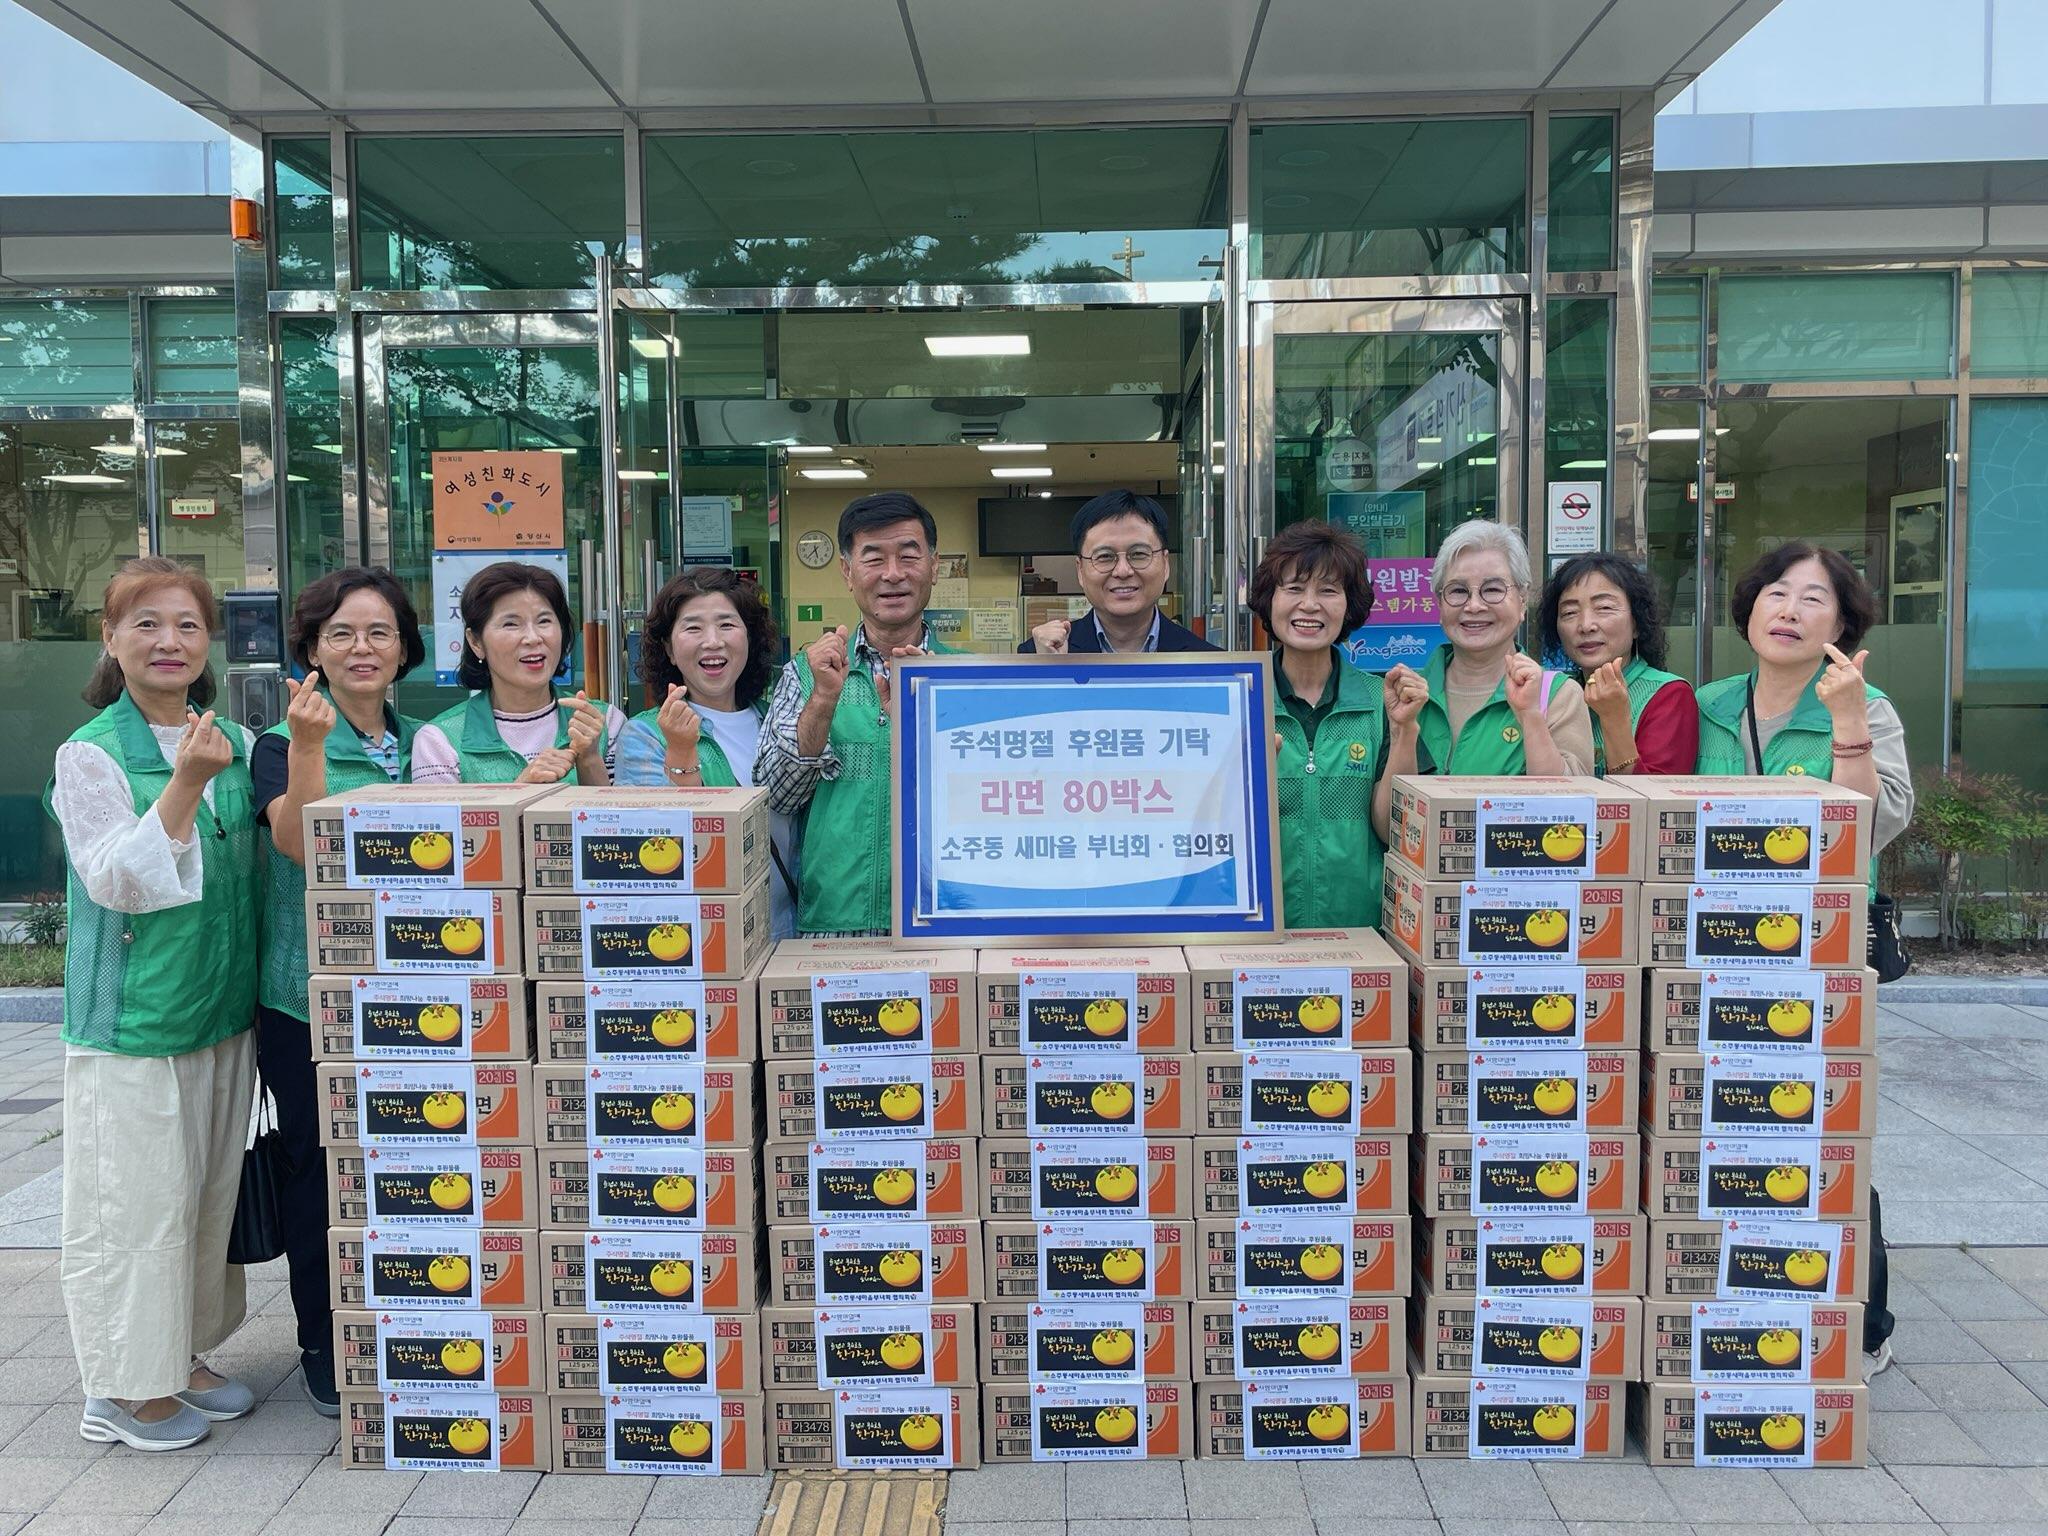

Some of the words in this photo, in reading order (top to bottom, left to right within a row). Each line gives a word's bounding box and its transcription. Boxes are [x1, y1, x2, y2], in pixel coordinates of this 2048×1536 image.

[444, 466, 551, 498] 여성친화도시
[1348, 515, 1406, 527] 무인발급기
[1383, 528, 1406, 540] 무료
[1367, 568, 1434, 592] 원발
[807, 607, 813, 620] 1
[1349, 639, 1426, 664] Yangsan
[950, 730, 1054, 758] 추석명절
[1068, 728, 1145, 758] 후원품
[1159, 728, 1210, 757] 기탁
[1346, 763, 1368, 772] SMU
[980, 780, 1044, 815] 라면
[1063, 780, 1174, 814] 80박스
[940, 836, 1004, 861] 소주동
[1015, 834, 1077, 860] 새마을
[1496, 838, 1536, 850] 한가위
[1716, 840, 1758, 852] 한가위
[364, 846, 404, 858] 한가위
[592, 851, 633, 863] 한가위
[334, 922, 372, 933] 가3478
[1479, 924, 1519, 935] 한가위
[1707, 927, 1749, 939] 한가위
[395, 930, 436, 943] 한가위
[601, 938, 642, 950] 한가위
[832, 1014, 873, 1027] 한가위
[1039, 1013, 1078, 1025] 한가위
[1253, 1010, 1292, 1022] 한가위
[1486, 1009, 1526, 1020] 한가위
[1720, 1012, 1761, 1025] 한가위
[373, 1017, 412, 1029] 한가위
[605, 1024, 646, 1035] 한가위
[1046, 1096, 1085, 1108] 한가위
[1262, 1093, 1302, 1106] 한가위
[1488, 1092, 1528, 1104] 한가위
[1723, 1094, 1763, 1106] 한가위
[377, 1105, 417, 1117] 한가위
[834, 1099, 874, 1111] 한가위
[606, 1107, 646, 1119] 한가위
[1050, 1180, 1090, 1191] 한가위
[1257, 1177, 1297, 1189] 한가위
[1490, 1175, 1530, 1186] 한가위
[1719, 1179, 1759, 1191] 한가위
[385, 1187, 424, 1198] 한가위
[608, 1188, 648, 1200] 한가위
[828, 1182, 868, 1194] 한가위
[1255, 1258, 1294, 1270] 한가위
[1496, 1258, 1535, 1269] 한가위
[1682, 1252, 1720, 1264] 가3478
[834, 1265, 874, 1276] 한가위
[1057, 1262, 1096, 1273] 한가위
[1738, 1259, 1779, 1273] 한가위
[383, 1268, 423, 1280] 한가위
[605, 1273, 644, 1285] 한가위
[1047, 1343, 1086, 1354] 한가위
[1253, 1339, 1292, 1351] 한가위
[1493, 1337, 1532, 1350] 한가위
[1711, 1342, 1751, 1354] 한가위
[396, 1352, 436, 1364] 한가위
[835, 1348, 875, 1360] 한가위
[618, 1356, 658, 1367] 한가위
[794, 1422, 830, 1432] 가3478
[1050, 1420, 1089, 1432] 한가위
[1262, 1419, 1302, 1431] 한가위
[1488, 1418, 1527, 1430] 한가위
[404, 1430, 442, 1442] 한가위
[625, 1433, 664, 1445] 한가위
[855, 1429, 894, 1440] 한가위
[1714, 1427, 1754, 1439] 한가위
